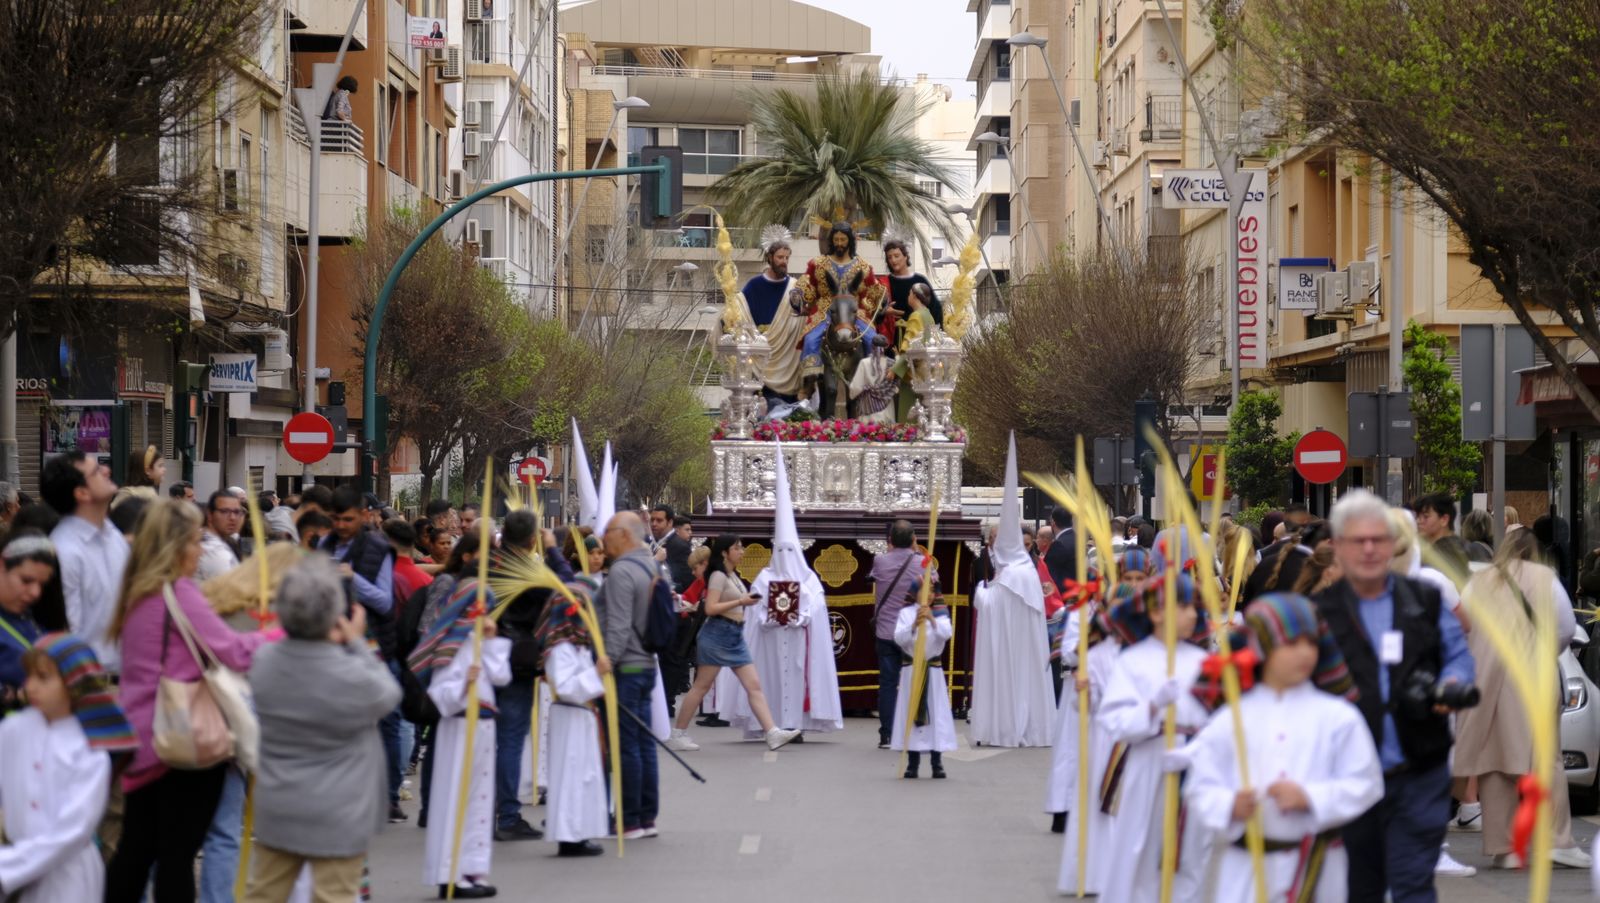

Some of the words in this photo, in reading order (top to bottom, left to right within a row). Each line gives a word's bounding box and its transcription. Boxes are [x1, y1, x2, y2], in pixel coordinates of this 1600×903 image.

[1190, 192, 1264, 202] COLLDO
[1238, 216, 1258, 360] muebles
[210, 356, 256, 383] SERVIPRIX
[15, 378, 48, 390] RIOS
